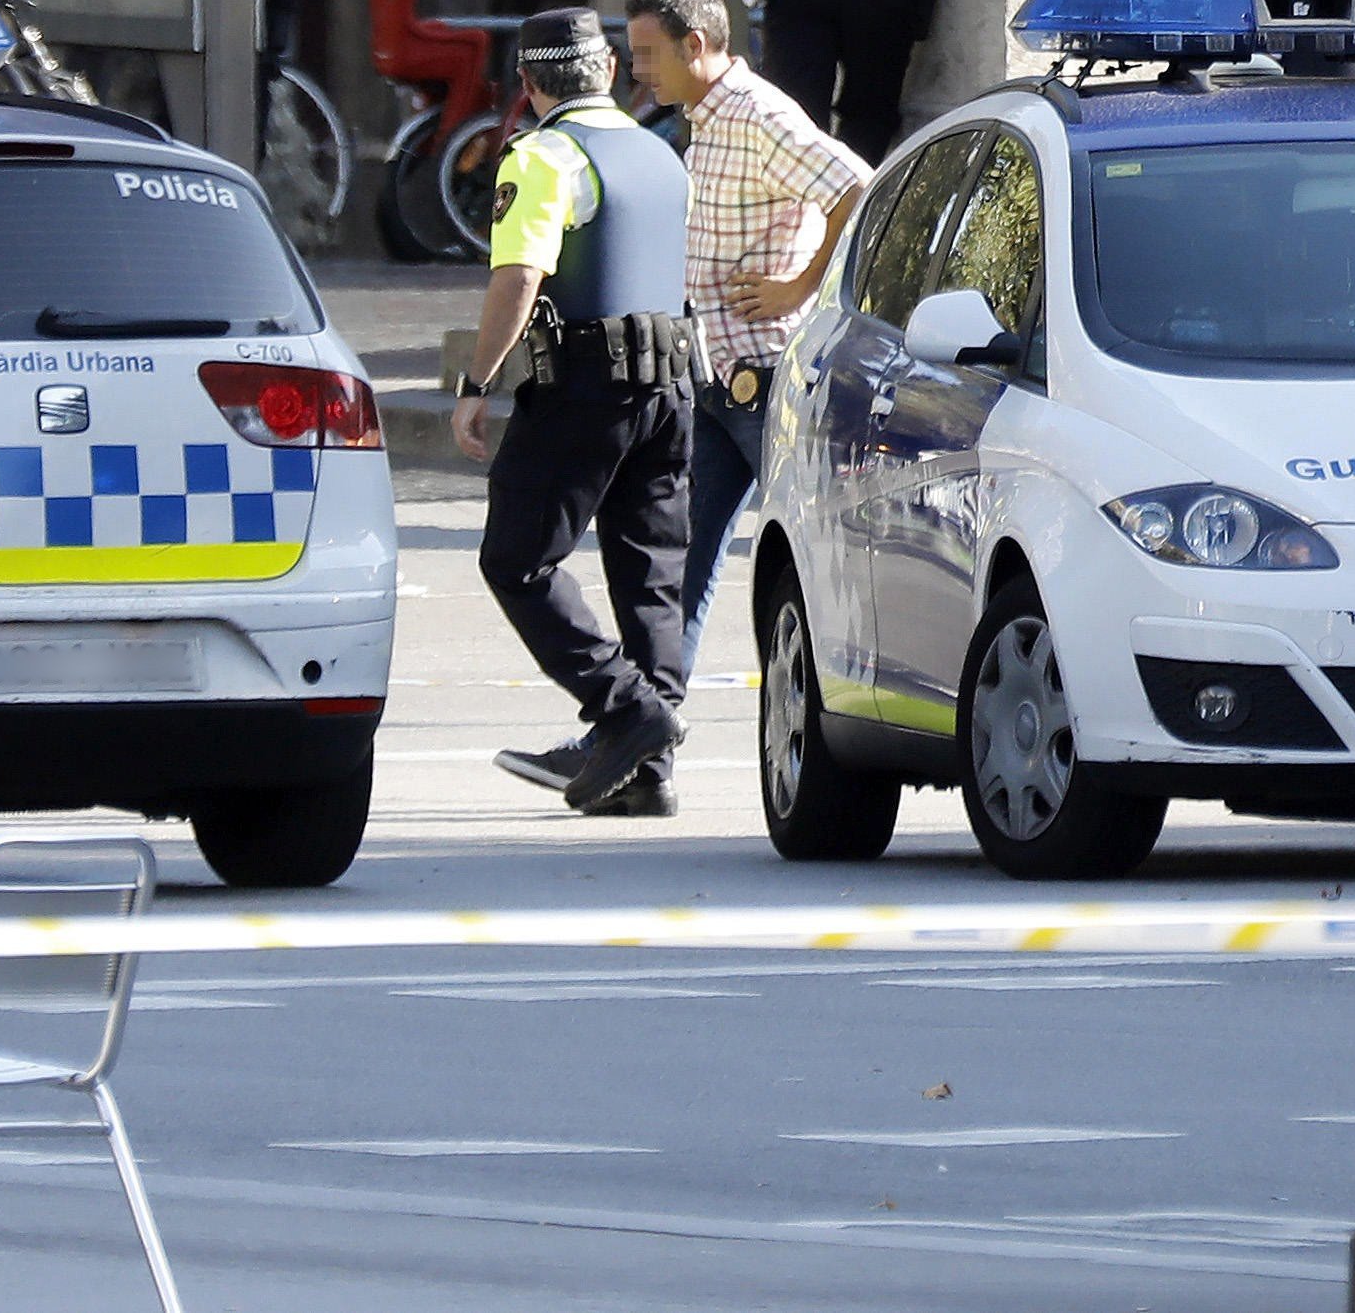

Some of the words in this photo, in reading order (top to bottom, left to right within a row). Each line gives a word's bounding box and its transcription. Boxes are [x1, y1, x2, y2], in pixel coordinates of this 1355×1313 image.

[113, 172, 238, 210] Policia
[67, 351, 155, 374] Urbana
[236, 343, 293, 363] C-700
